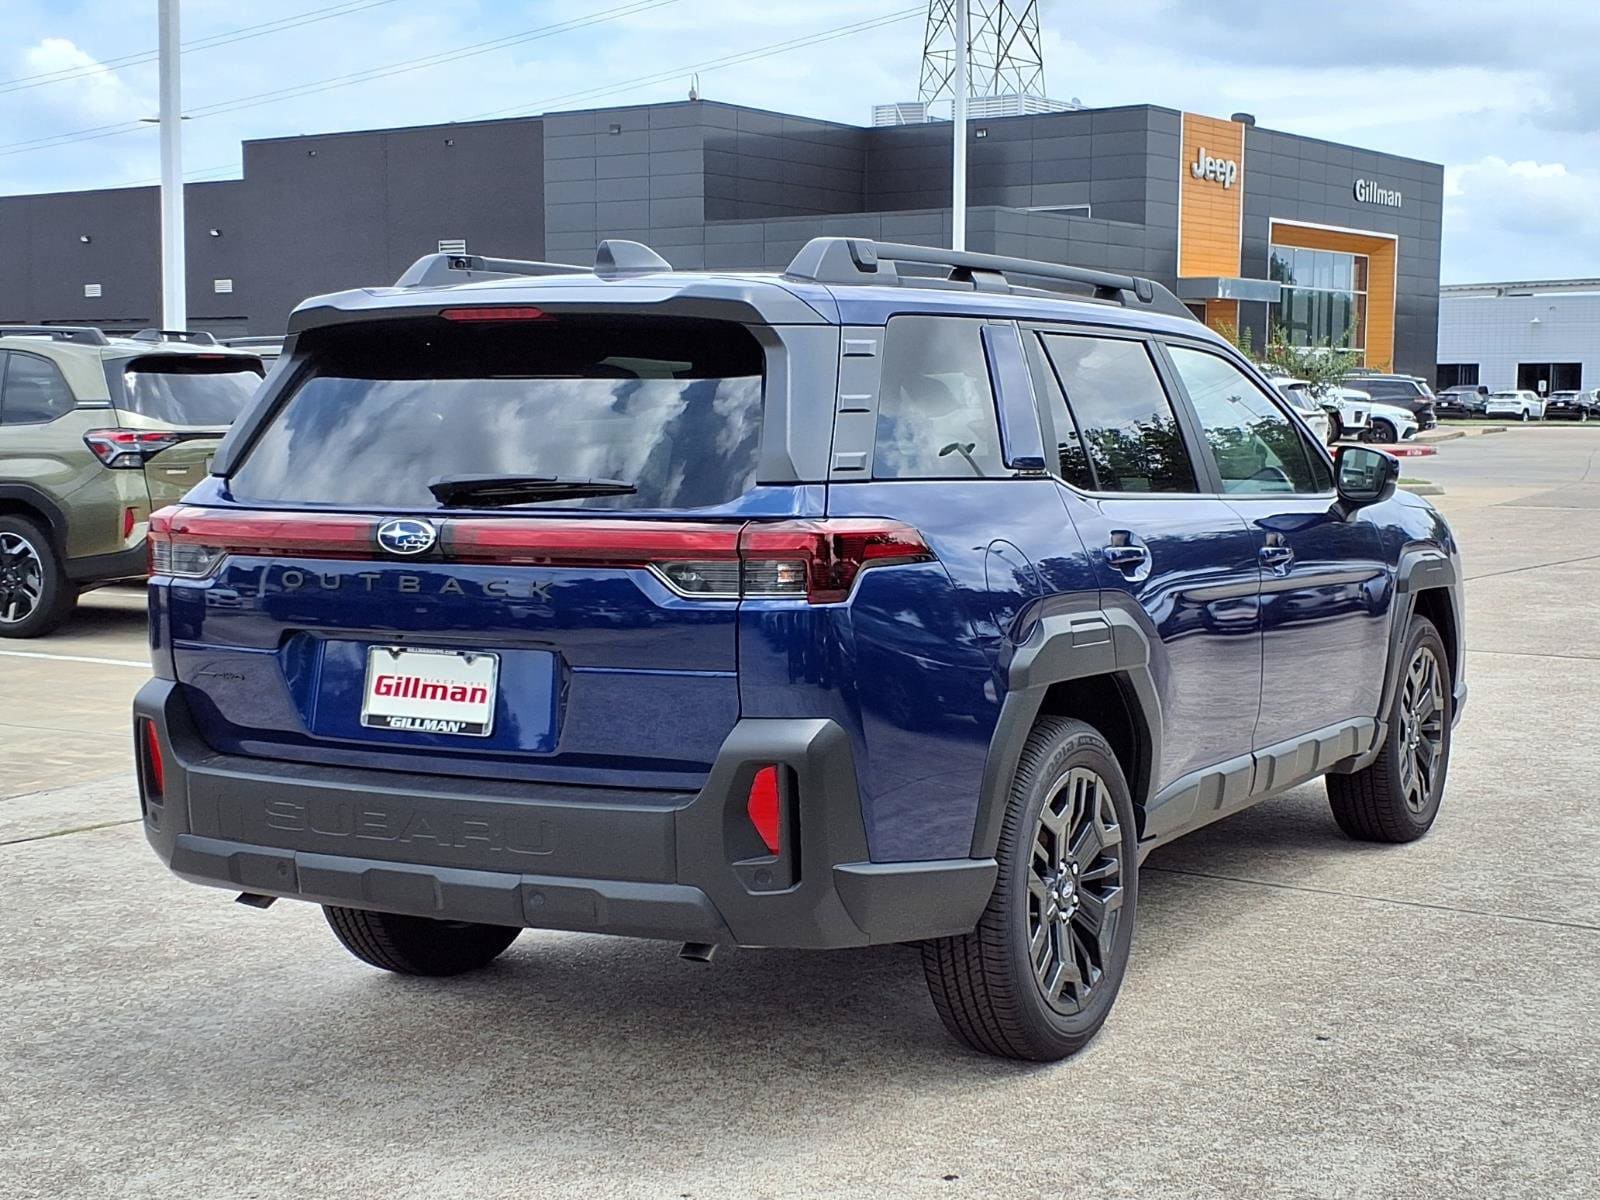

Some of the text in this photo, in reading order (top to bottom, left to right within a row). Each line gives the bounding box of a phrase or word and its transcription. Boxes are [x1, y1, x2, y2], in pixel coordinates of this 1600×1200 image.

[1191, 147, 1238, 190] Jeep
[1354, 178, 1402, 208] Gillman
[281, 570, 553, 601] OUTBACK
[374, 674, 488, 704] Gillman
[264, 799, 556, 855] SUBARU
